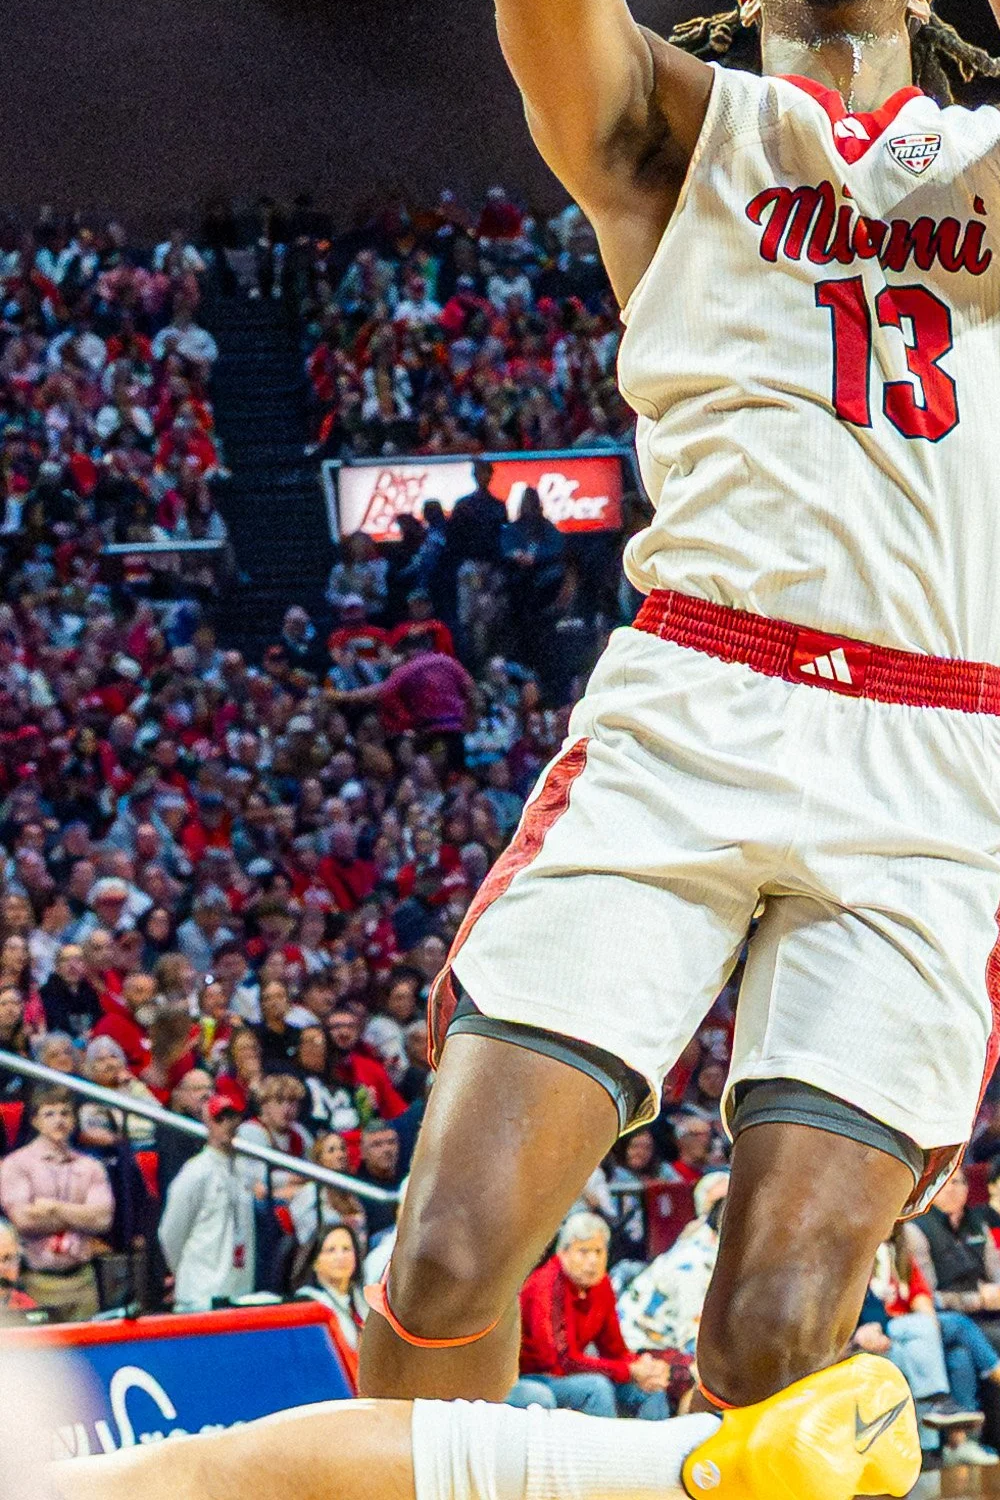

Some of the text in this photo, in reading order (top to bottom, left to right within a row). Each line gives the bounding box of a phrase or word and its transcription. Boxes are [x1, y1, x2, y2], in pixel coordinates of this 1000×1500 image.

[894, 143, 941, 159] MAC
[745, 180, 993, 276] Miami
[814, 275, 961, 444] 13
